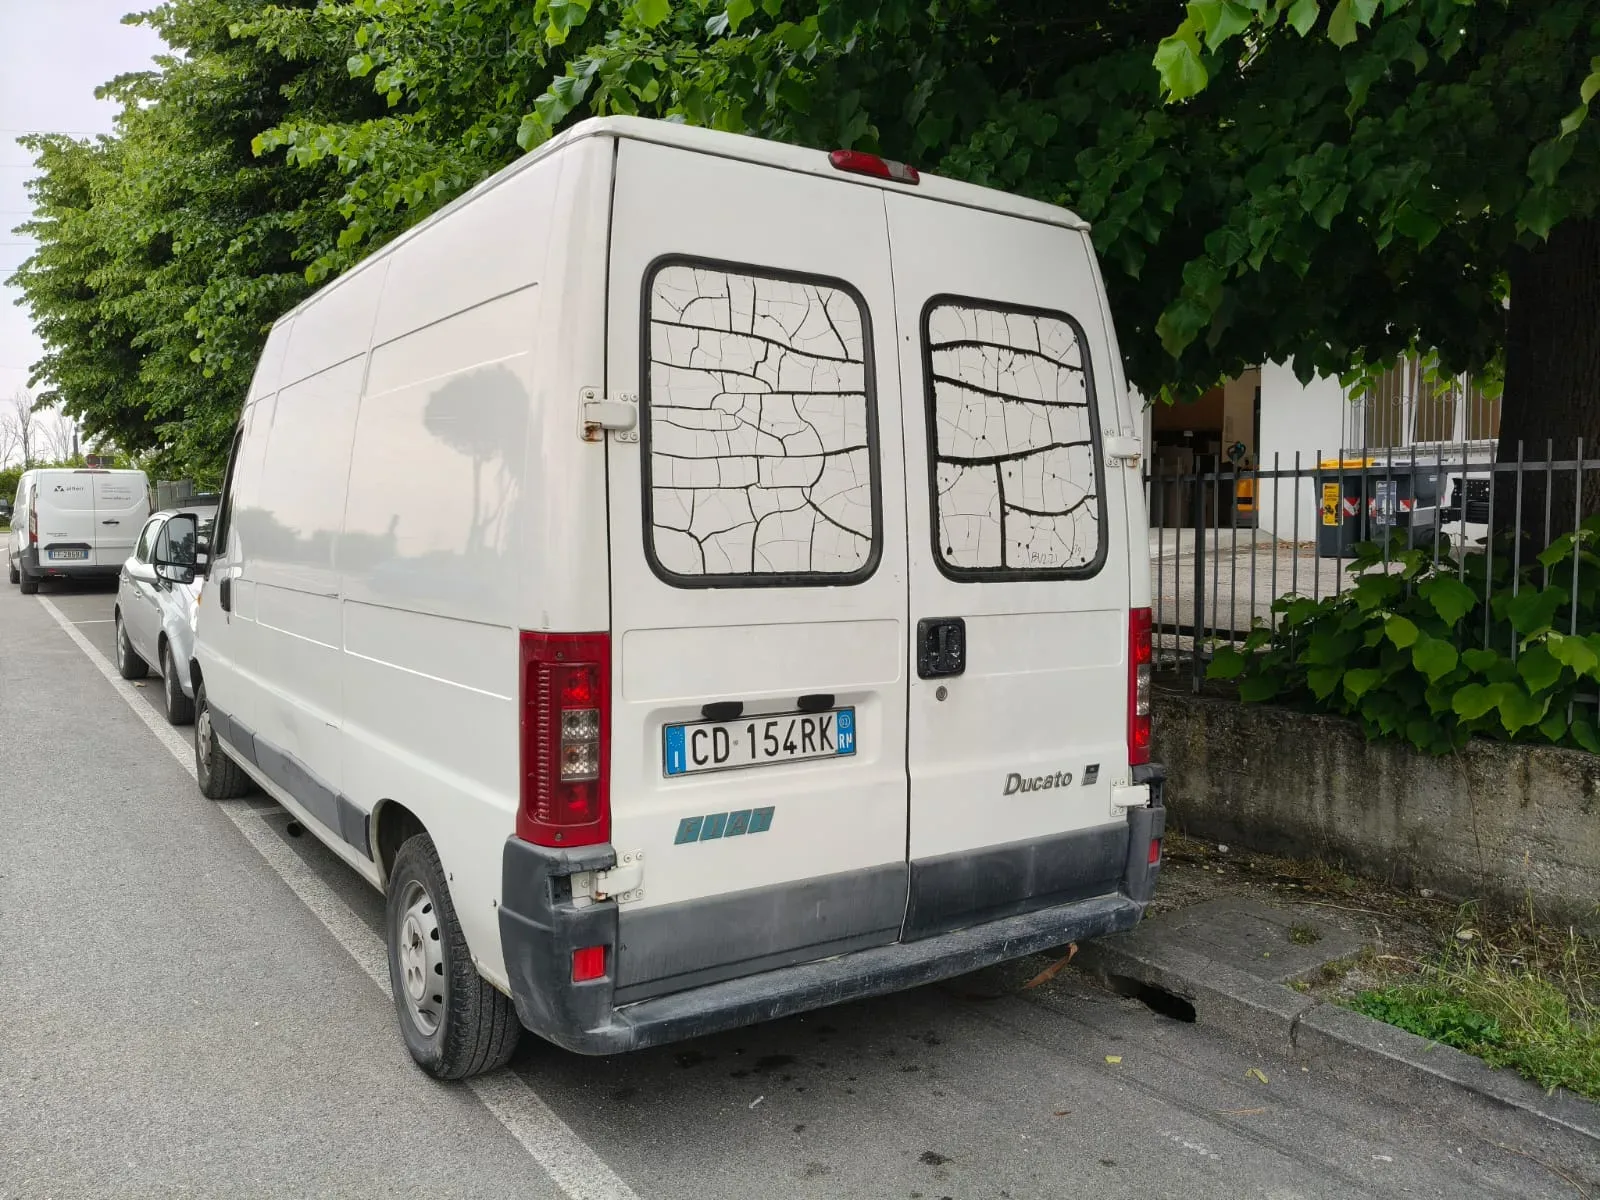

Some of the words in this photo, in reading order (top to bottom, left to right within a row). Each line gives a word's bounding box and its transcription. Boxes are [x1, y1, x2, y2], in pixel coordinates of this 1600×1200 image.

[691, 726, 730, 765] CD
[747, 715, 834, 759] 154RK
[1003, 771, 1073, 796] Ducato
[679, 807, 774, 843] FIAT
